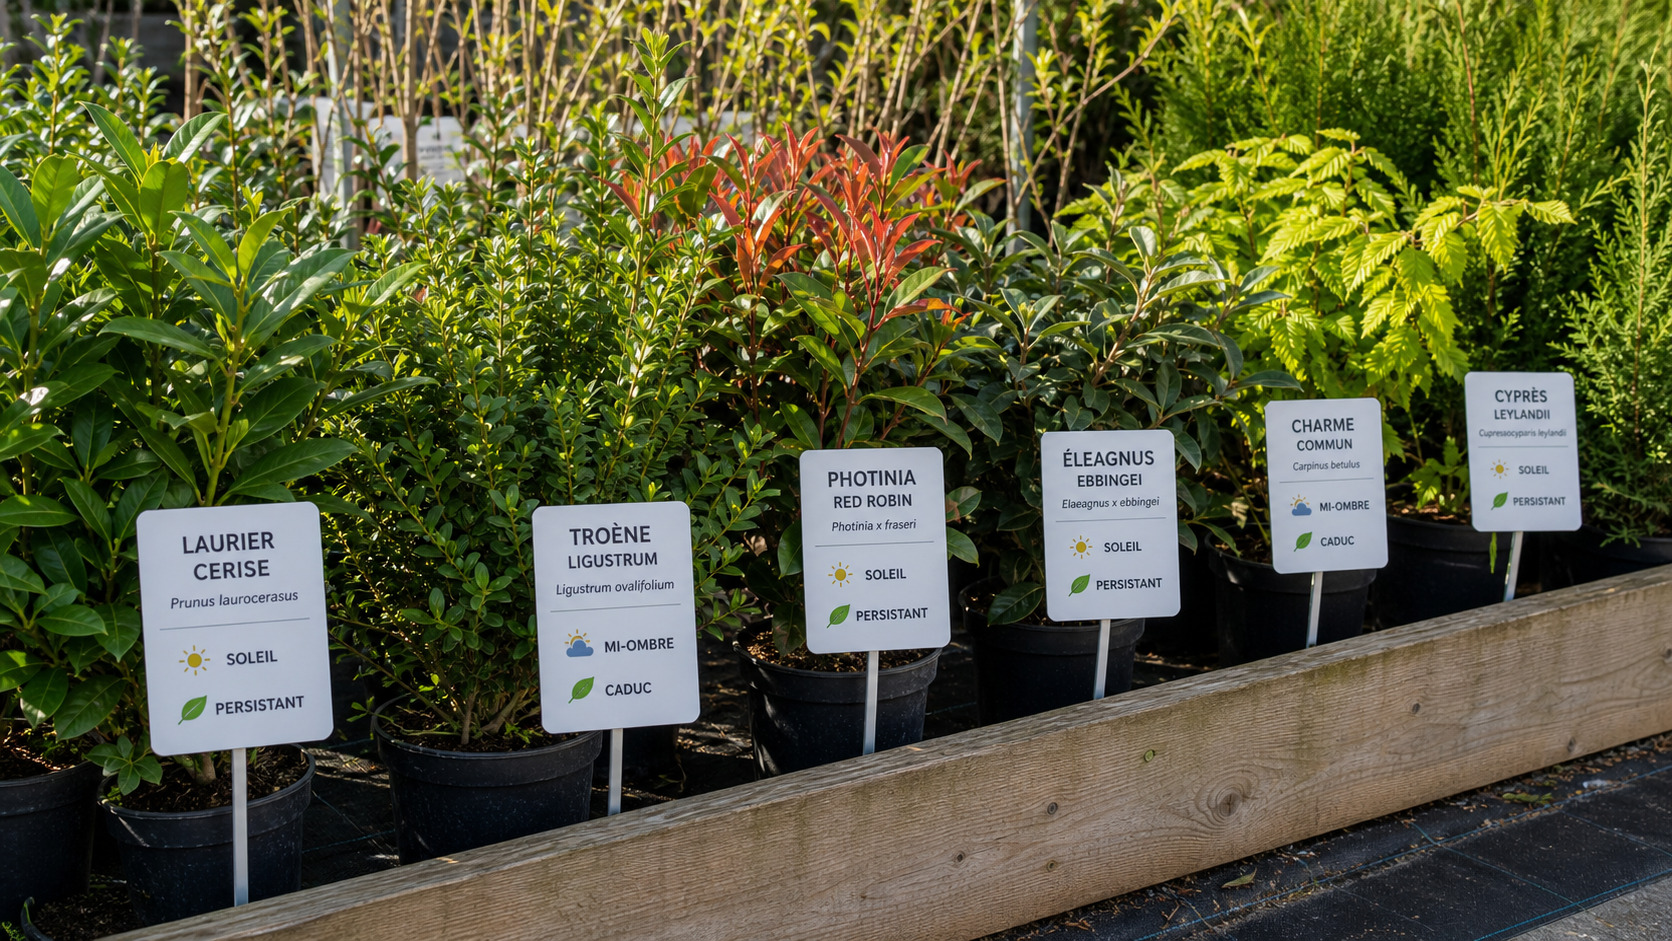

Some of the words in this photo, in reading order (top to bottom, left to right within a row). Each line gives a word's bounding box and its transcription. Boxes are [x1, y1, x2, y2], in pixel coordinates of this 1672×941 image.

[1495, 387, 1548, 403] CYPRÈS
[1494, 409, 1550, 420] LEYLANDII
[1291, 418, 1355, 433] CHARME
[1538, 429, 1567, 438] leylandii
[1297, 439, 1352, 451] COMMUN
[1063, 448, 1154, 467] ÉLEAGNUS
[1293, 461, 1329, 472] Carpinus
[1331, 460, 1360, 469] betulus
[1519, 466, 1549, 475] SOLEIL
[828, 469, 916, 487] PHOTINIA
[1078, 474, 1142, 489] EBBINGEI
[834, 496, 862, 509] RED
[867, 494, 912, 507] ROBIN
[1062, 499, 1110, 510] Elaeagnus
[1120, 496, 1160, 508] ebbingei
[1320, 500, 1370, 511] MI-OMBRE
[1513, 496, 1566, 506] PERSISTANT
[832, 520, 874, 531] Photinia
[885, 519, 916, 530] fraseri
[569, 522, 651, 546] TROÈNE
[183, 531, 275, 554] LAURIER
[1104, 541, 1142, 553] SOLEIL
[1321, 536, 1354, 547] CADUC
[568, 552, 658, 569] LIGUSTRUM
[194, 559, 270, 581] CERISE
[865, 568, 907, 580] SOLEIL
[556, 584, 612, 597] Ligustrum
[615, 579, 674, 594] ovalifolium
[1096, 578, 1162, 590] PERSISTANT
[171, 598, 215, 609] Prunus
[219, 592, 298, 606] laurocerasus
[856, 607, 928, 621] PERSISTANT
[605, 637, 674, 653] MI-OMBRE
[227, 650, 278, 666] SOLEIL
[605, 682, 652, 696] CADUC
[216, 696, 304, 715] PERSISTANT
